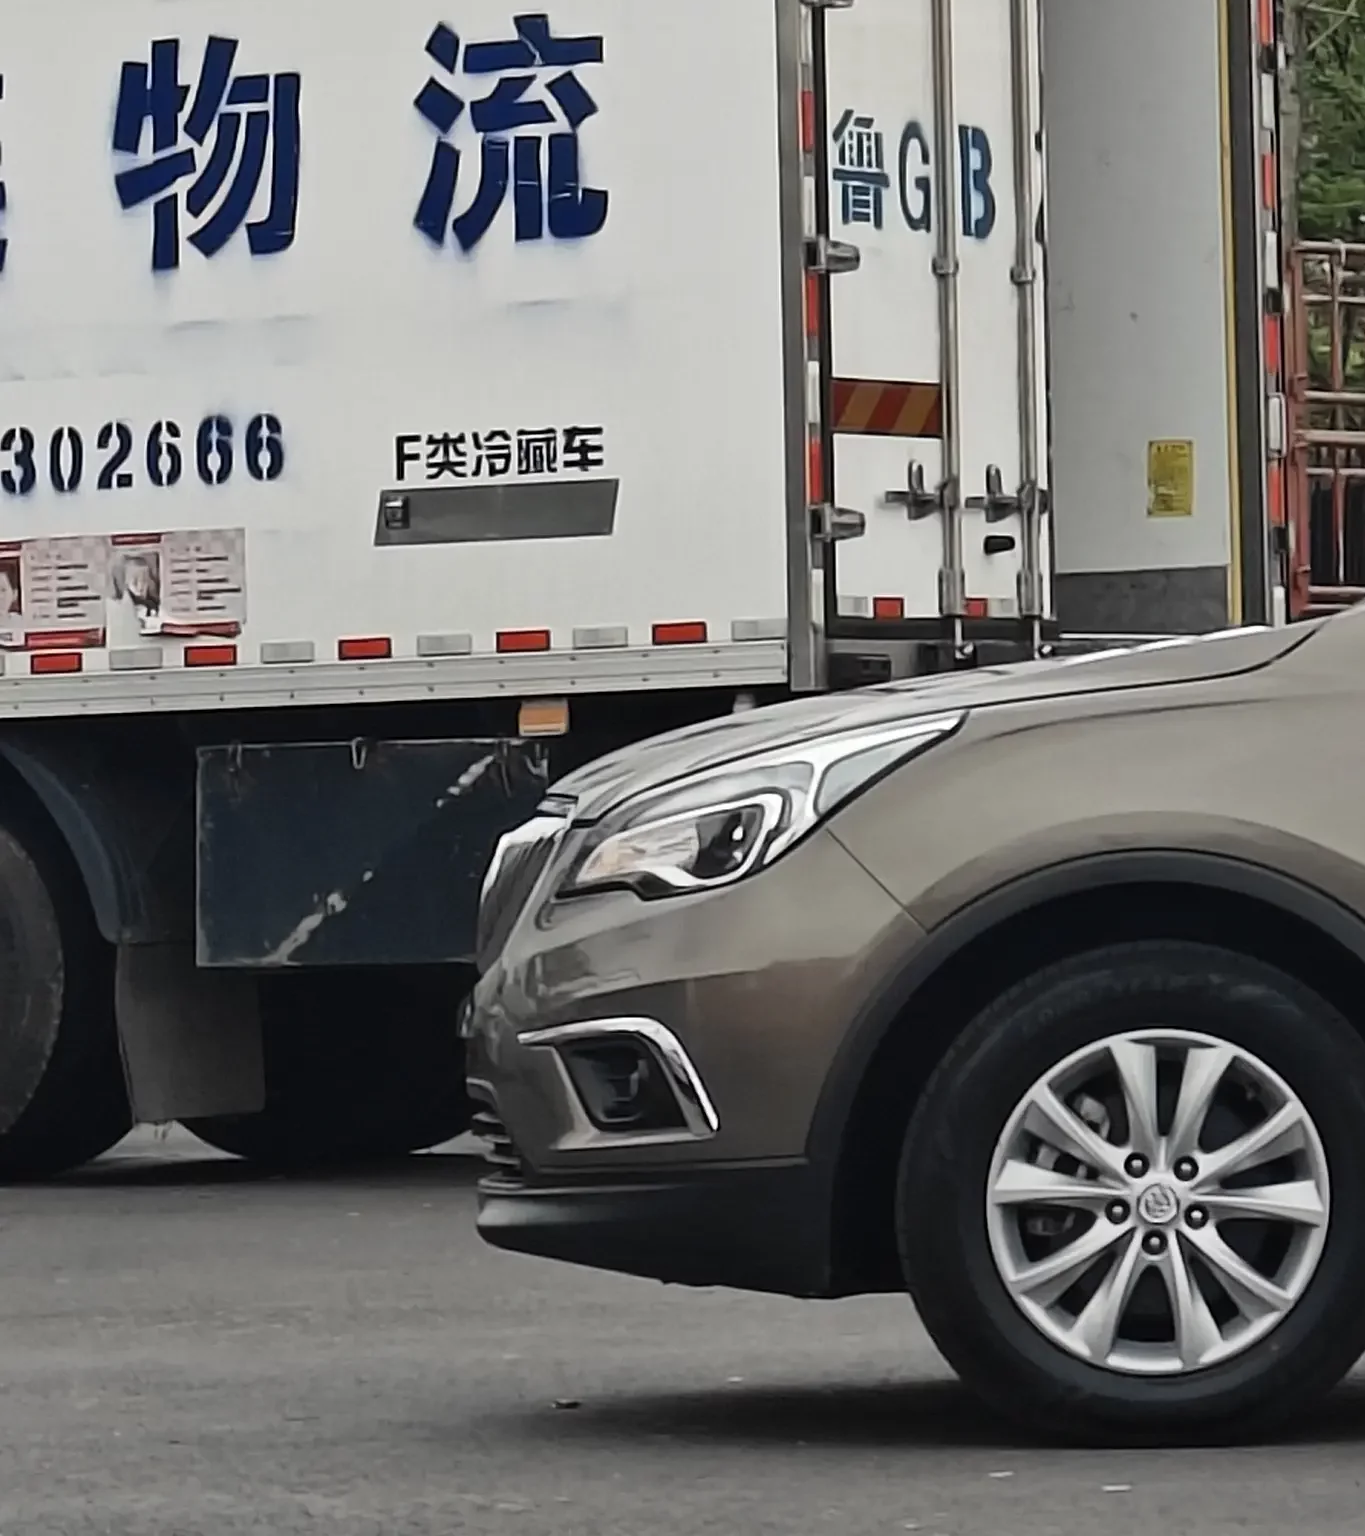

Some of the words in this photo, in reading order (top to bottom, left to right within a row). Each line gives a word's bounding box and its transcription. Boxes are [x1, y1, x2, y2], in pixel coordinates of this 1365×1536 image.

[0, 13, 609, 271] 物流
[832, 109, 1043, 242] 鲁GB
[0, 413, 285, 495] 302666
